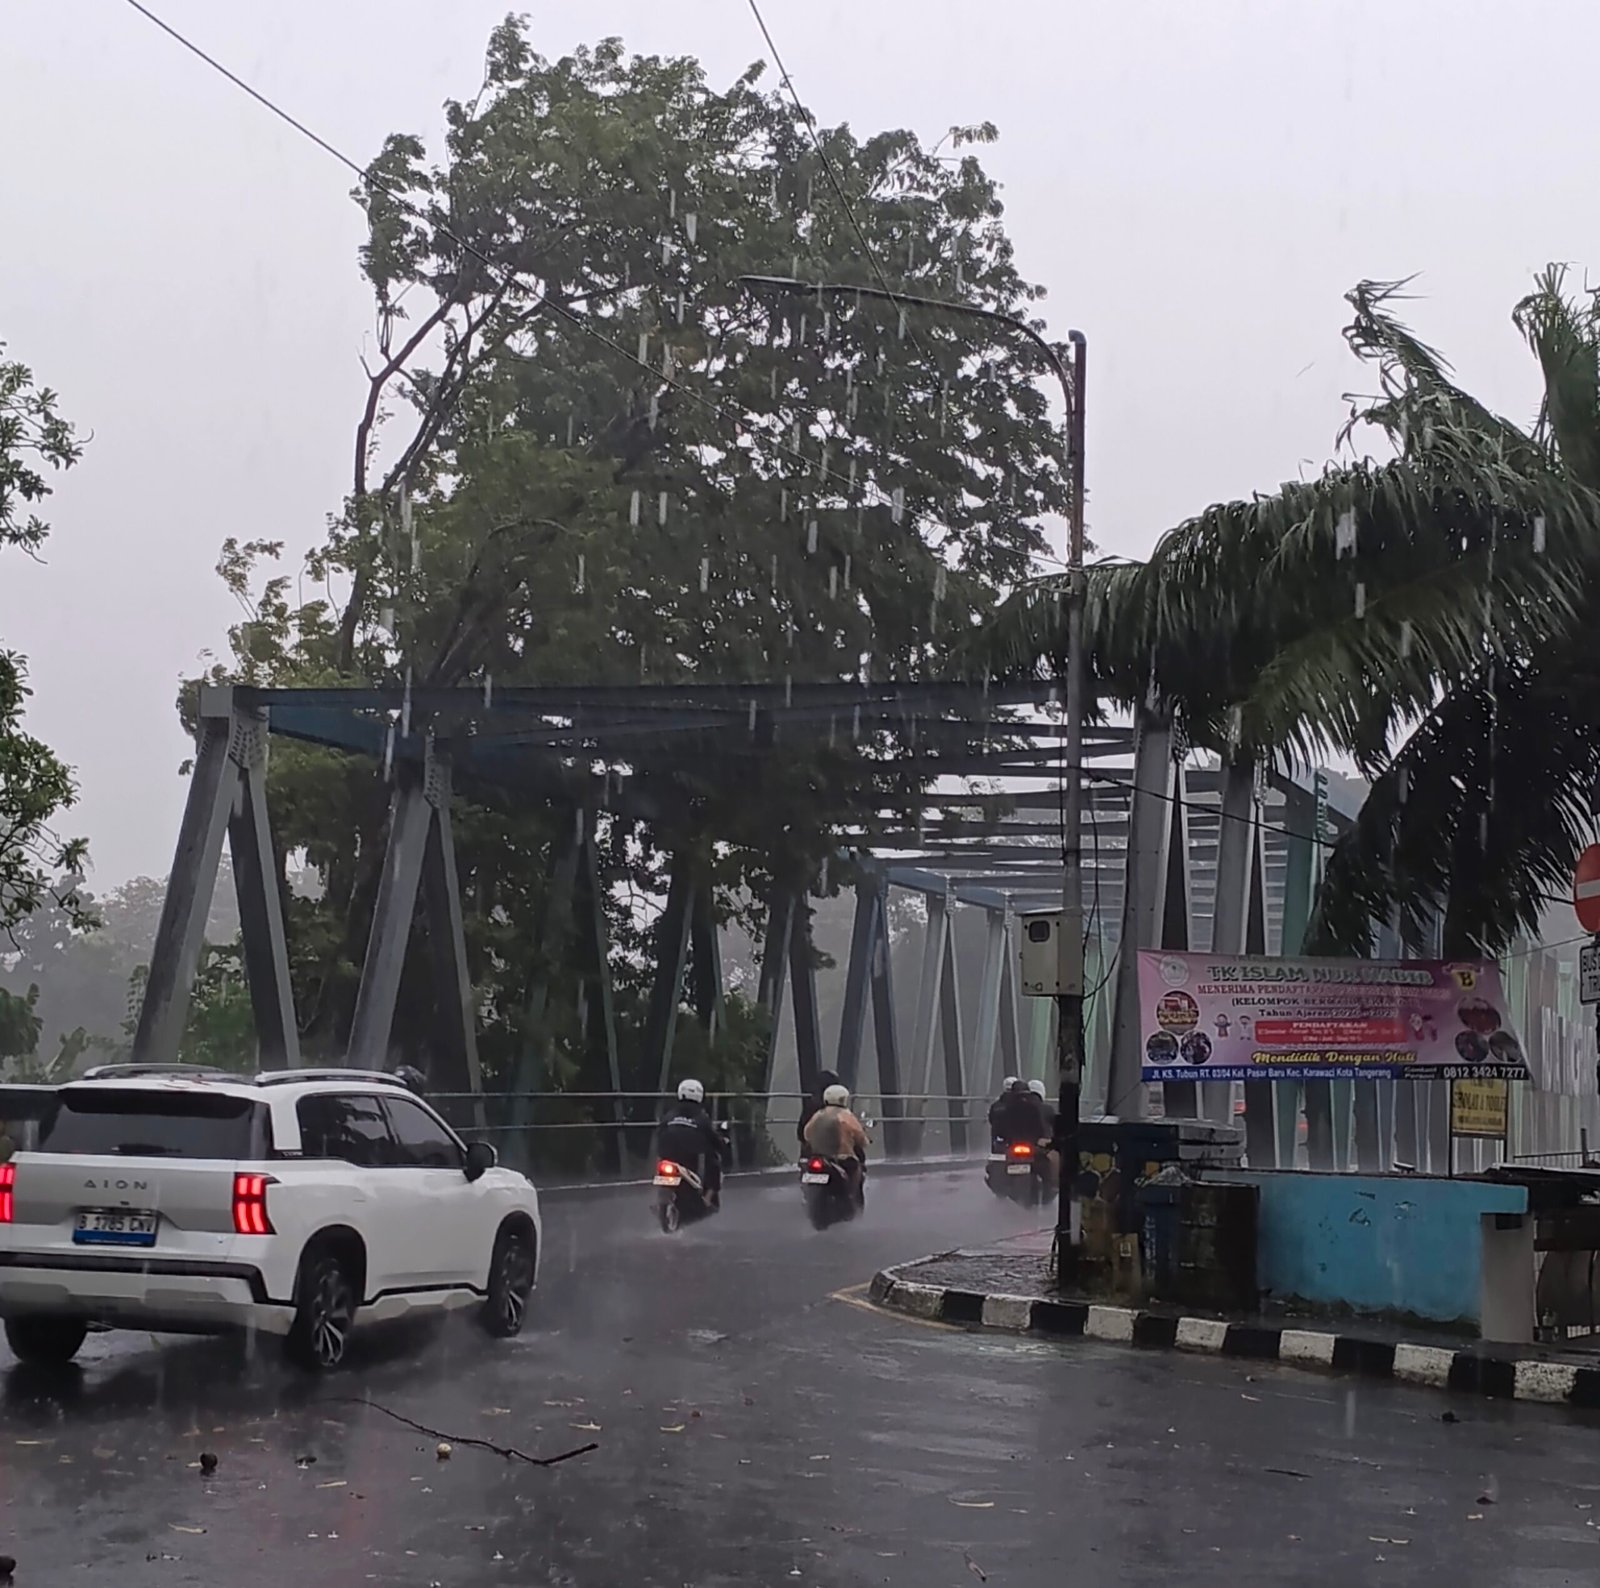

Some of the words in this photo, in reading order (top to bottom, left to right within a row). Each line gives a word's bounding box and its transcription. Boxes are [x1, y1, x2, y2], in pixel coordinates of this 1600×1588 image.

[1206, 966, 1238, 982] TK
[1240, 966, 1309, 983] ISLAM
[1197, 984, 1255, 995] MENERIMA
[1588, 975, 1600, 993] TR
[1231, 997, 1300, 1007] (KELOMPOK
[1259, 1009, 1292, 1017] Tahun
[1252, 1052, 1321, 1063] Mendidik
[1324, 1051, 1380, 1065] Dengan
[1384, 1051, 1416, 1063] Hati
[1176, 1070, 1199, 1078] Tubun
[1200, 1069, 1210, 1078] RT.
[1247, 1069, 1267, 1077] Pasar
[1268, 1068, 1285, 1077] Baru
[1286, 1068, 1301, 1077] Kec.
[1303, 1068, 1335, 1077] Karawaci
[1336, 1068, 1353, 1077] Kota
[1355, 1068, 1391, 1079] Tangerang
[1443, 1066, 1470, 1078] 0812
[1472, 1066, 1498, 1079] 3424
[1500, 1067, 1526, 1079] 7277
[83, 1179, 148, 1190] AION
